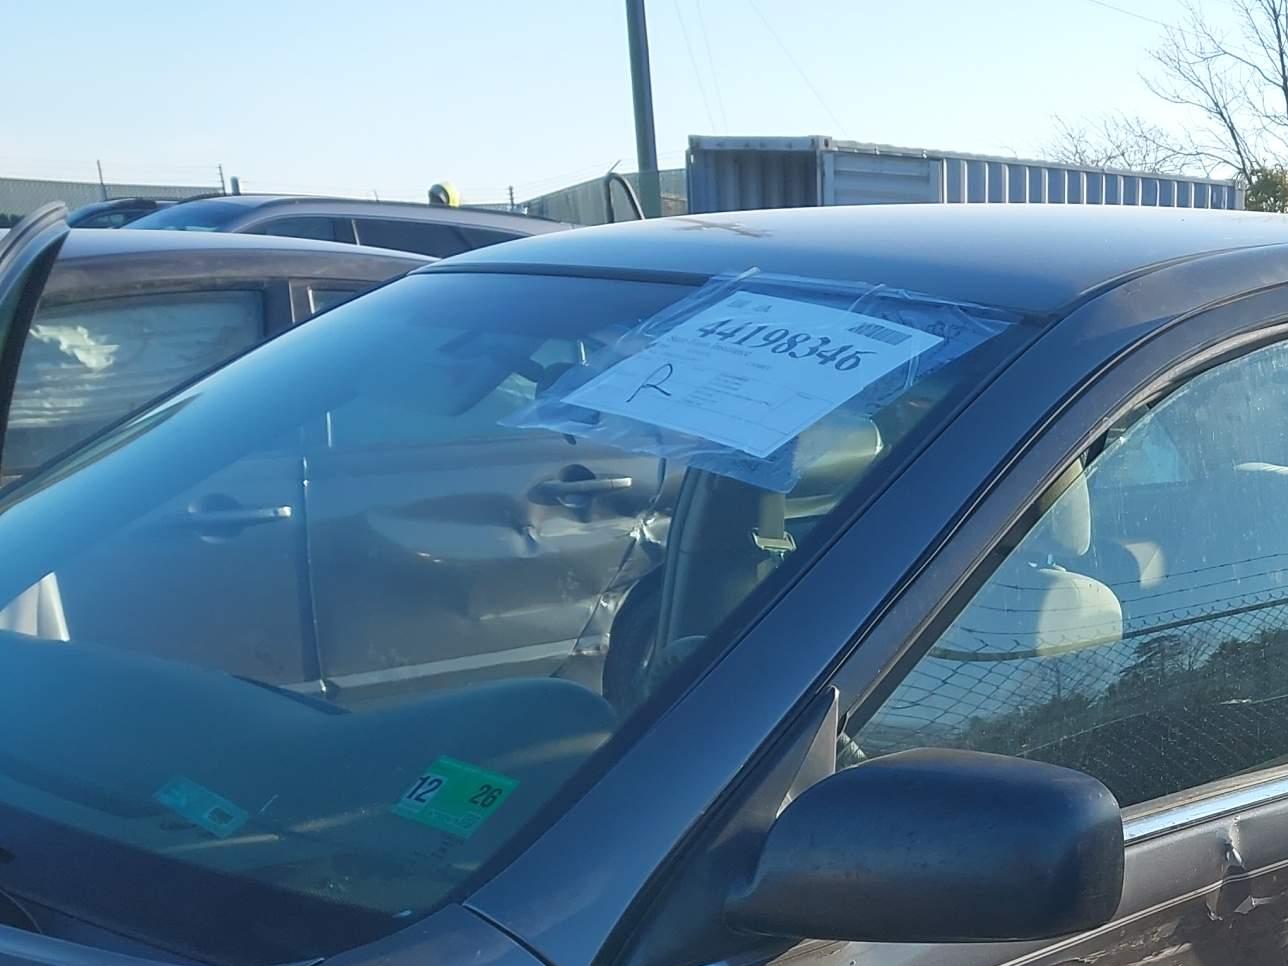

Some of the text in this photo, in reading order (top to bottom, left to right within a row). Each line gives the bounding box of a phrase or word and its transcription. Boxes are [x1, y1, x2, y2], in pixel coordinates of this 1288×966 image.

[698, 318, 878, 371] 44198346
[406, 775, 504, 808] 12 26
